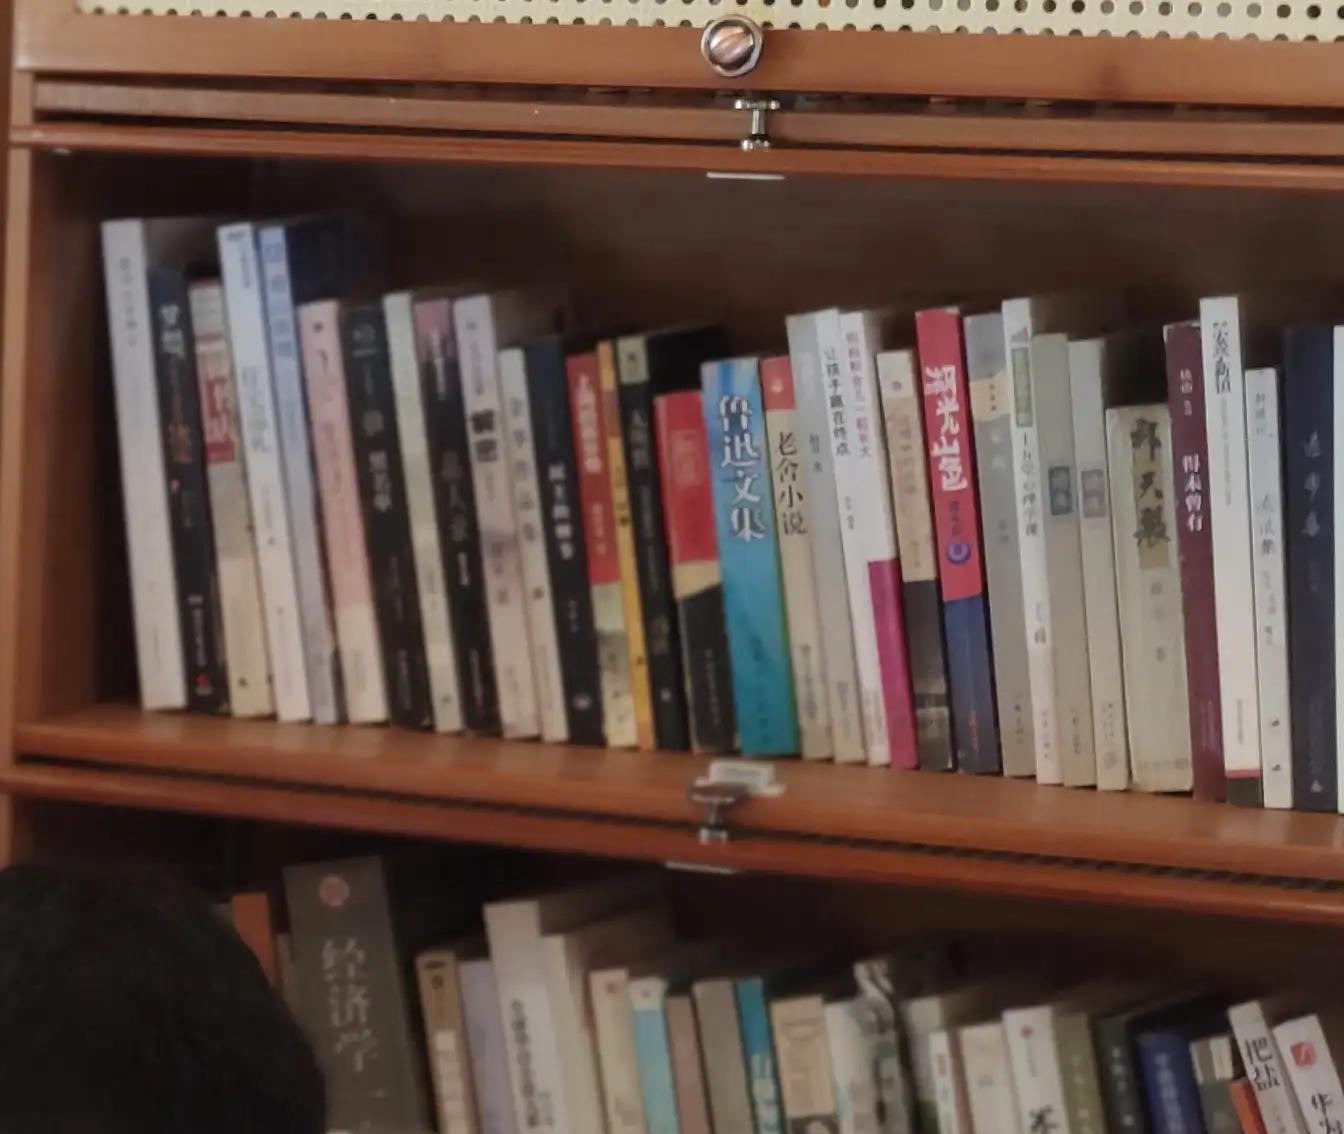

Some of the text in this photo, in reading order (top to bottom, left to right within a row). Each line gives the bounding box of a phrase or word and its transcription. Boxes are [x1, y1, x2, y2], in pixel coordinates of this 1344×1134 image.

[720, 395, 766, 542] 鲁迅文集
[778, 431, 808, 536] 老舍小说
[320, 936, 380, 1074] 经济学
